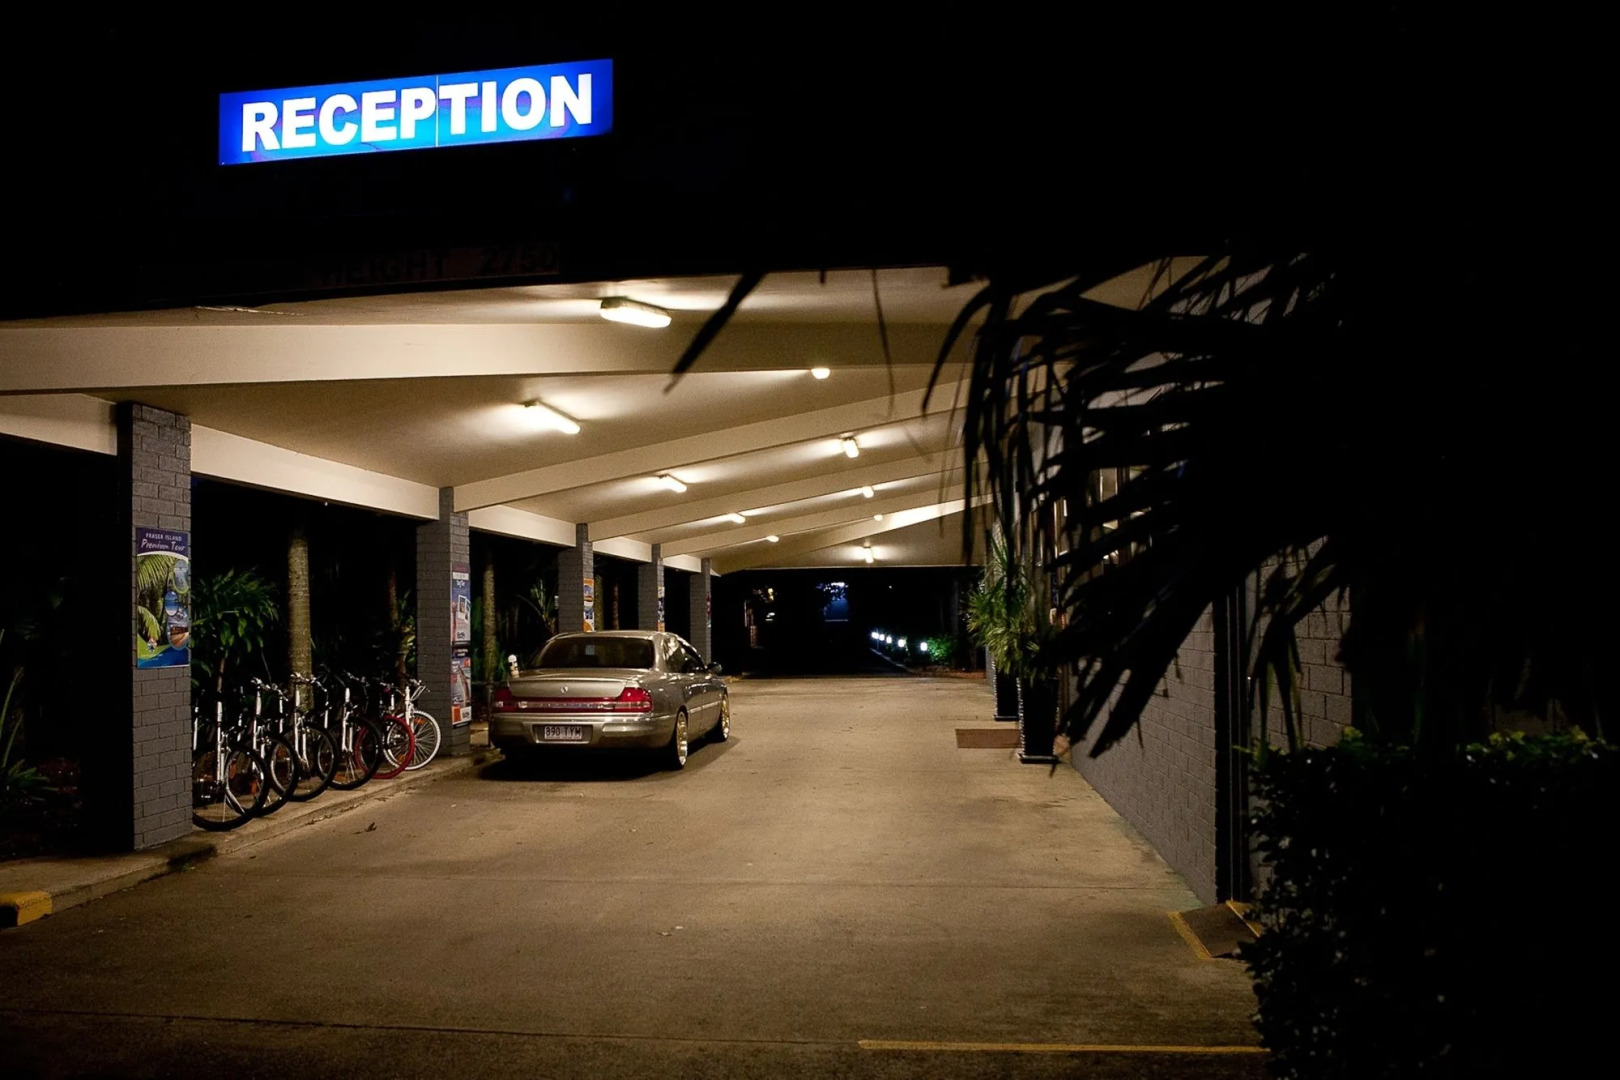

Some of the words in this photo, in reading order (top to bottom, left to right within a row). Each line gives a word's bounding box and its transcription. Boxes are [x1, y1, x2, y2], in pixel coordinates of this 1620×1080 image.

[241, 73, 592, 152] RECEPTION
[141, 538, 169, 549] Premium
[171, 541, 186, 551] Tour
